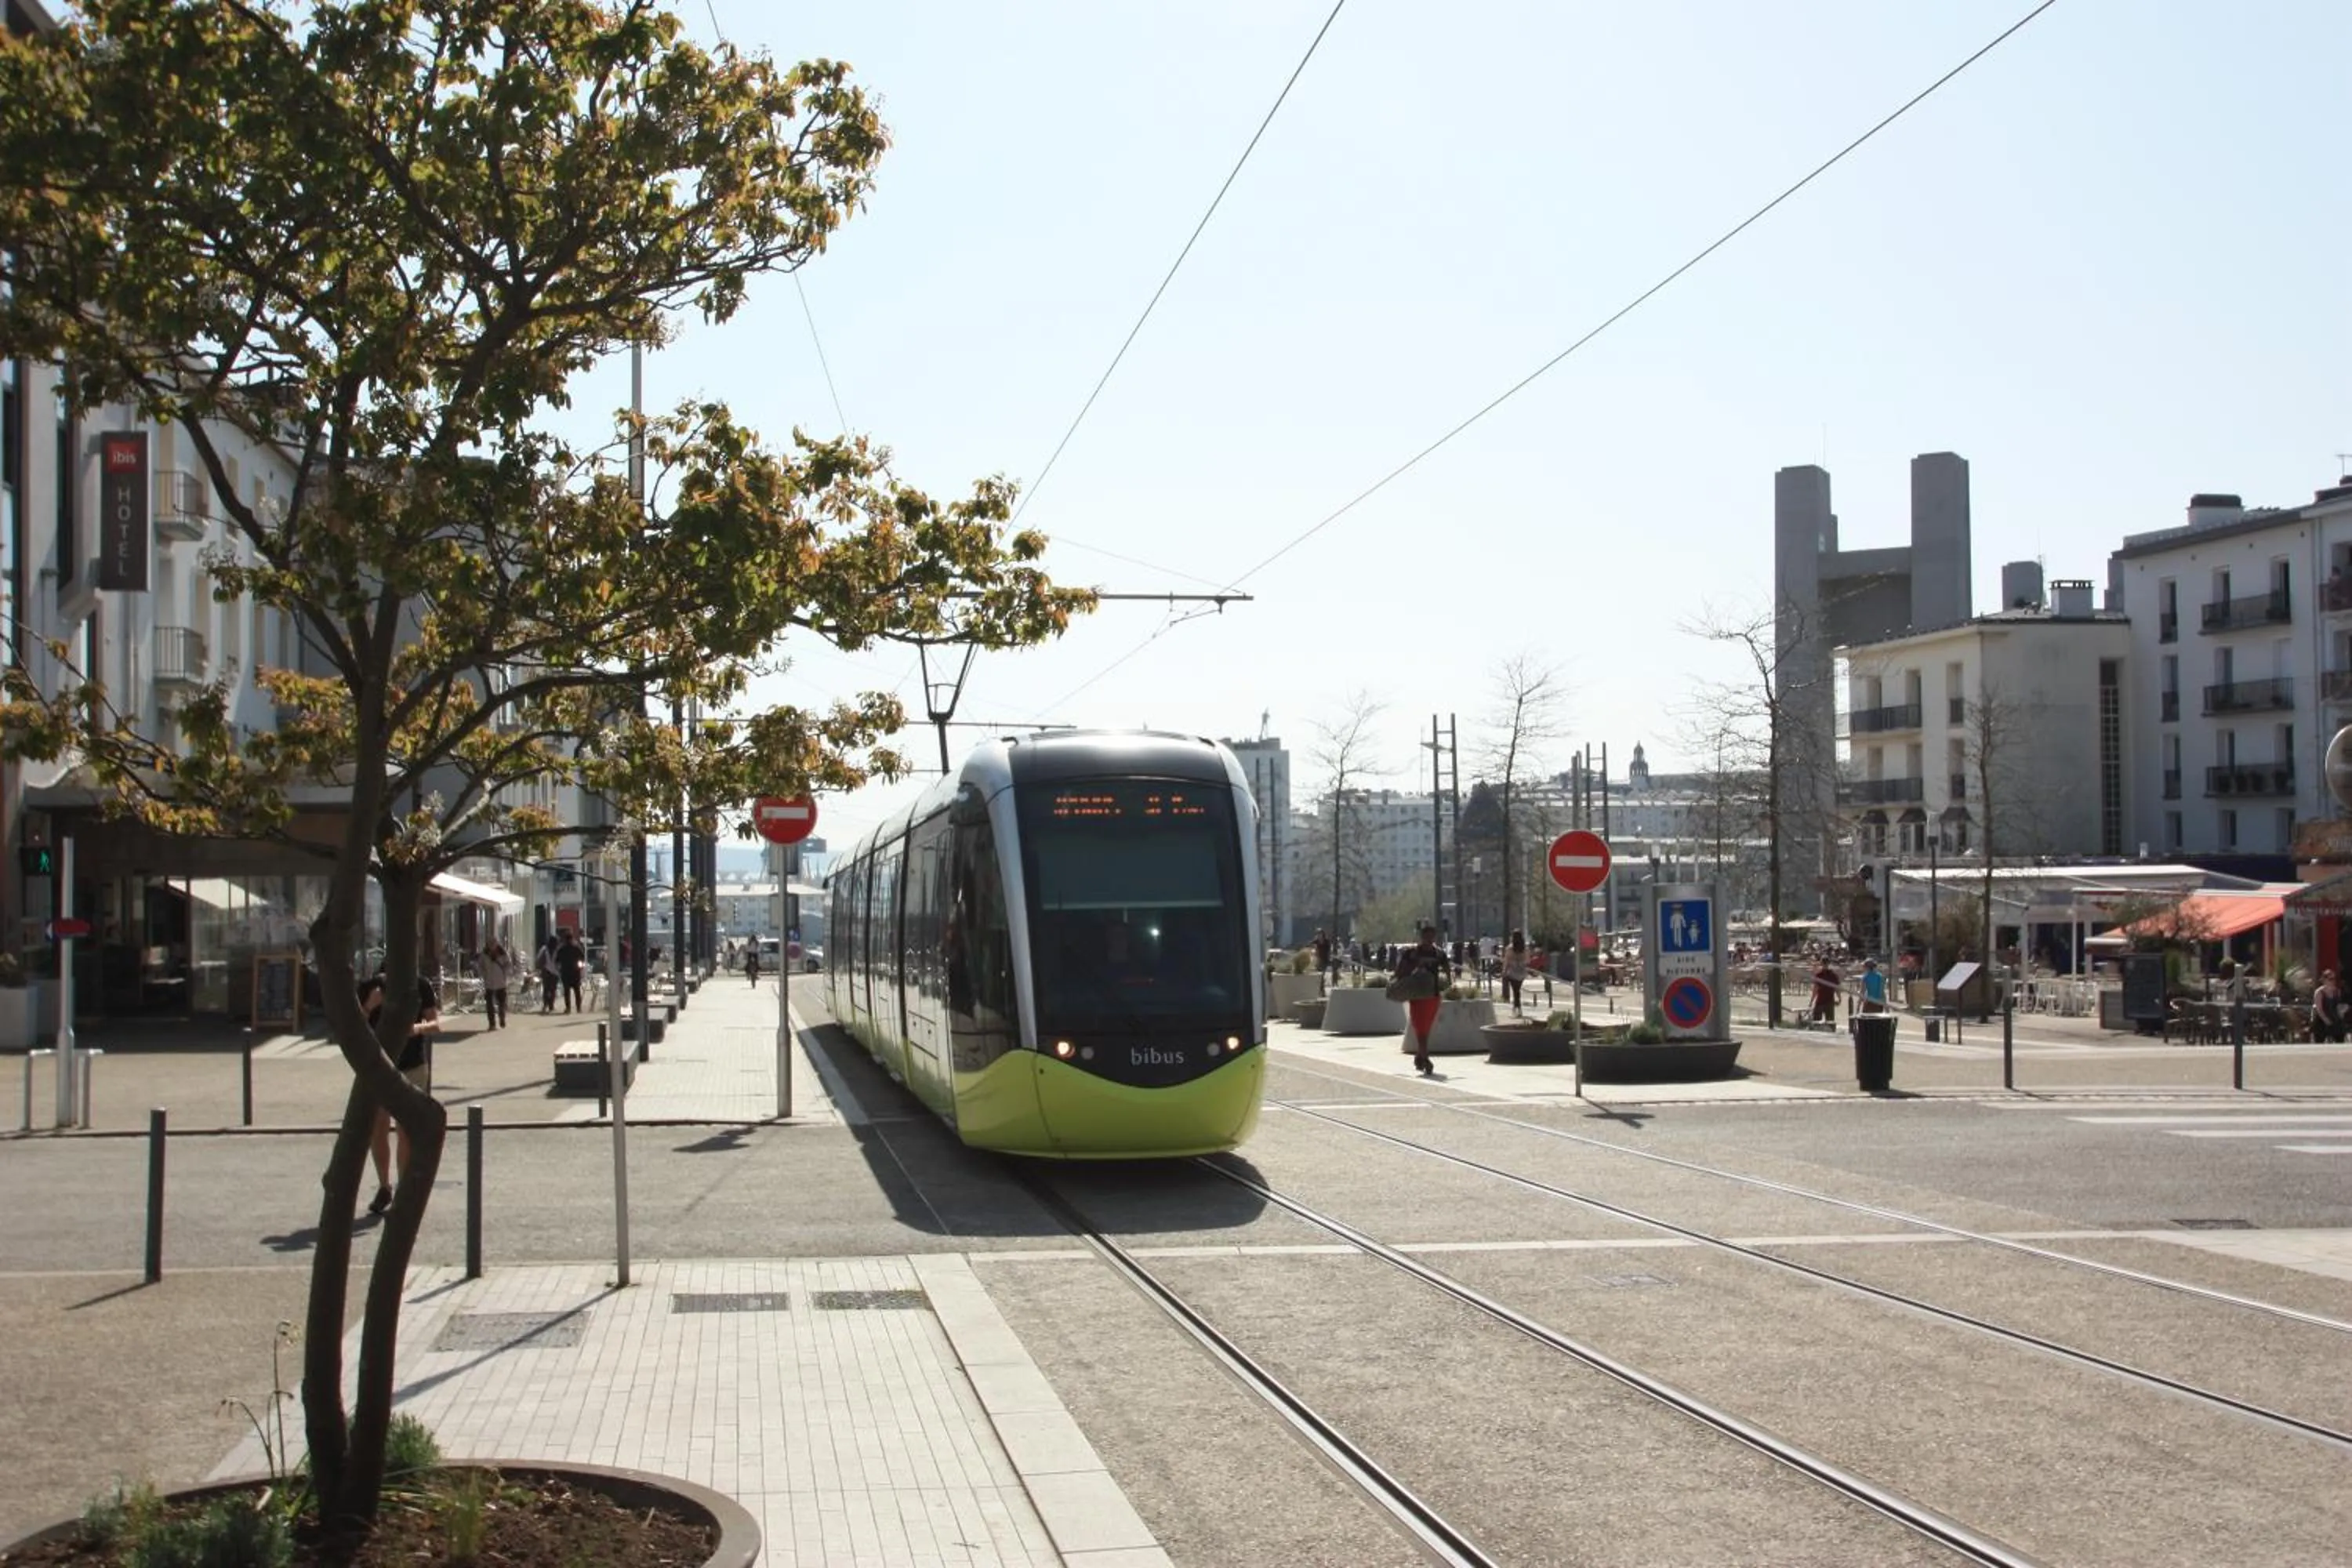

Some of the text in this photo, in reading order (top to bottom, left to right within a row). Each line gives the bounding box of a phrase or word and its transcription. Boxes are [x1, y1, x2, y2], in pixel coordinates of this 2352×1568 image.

[113, 451, 136, 464] ibis
[118, 487, 131, 576] HOTEL
[1131, 1047, 1184, 1065] bibus
